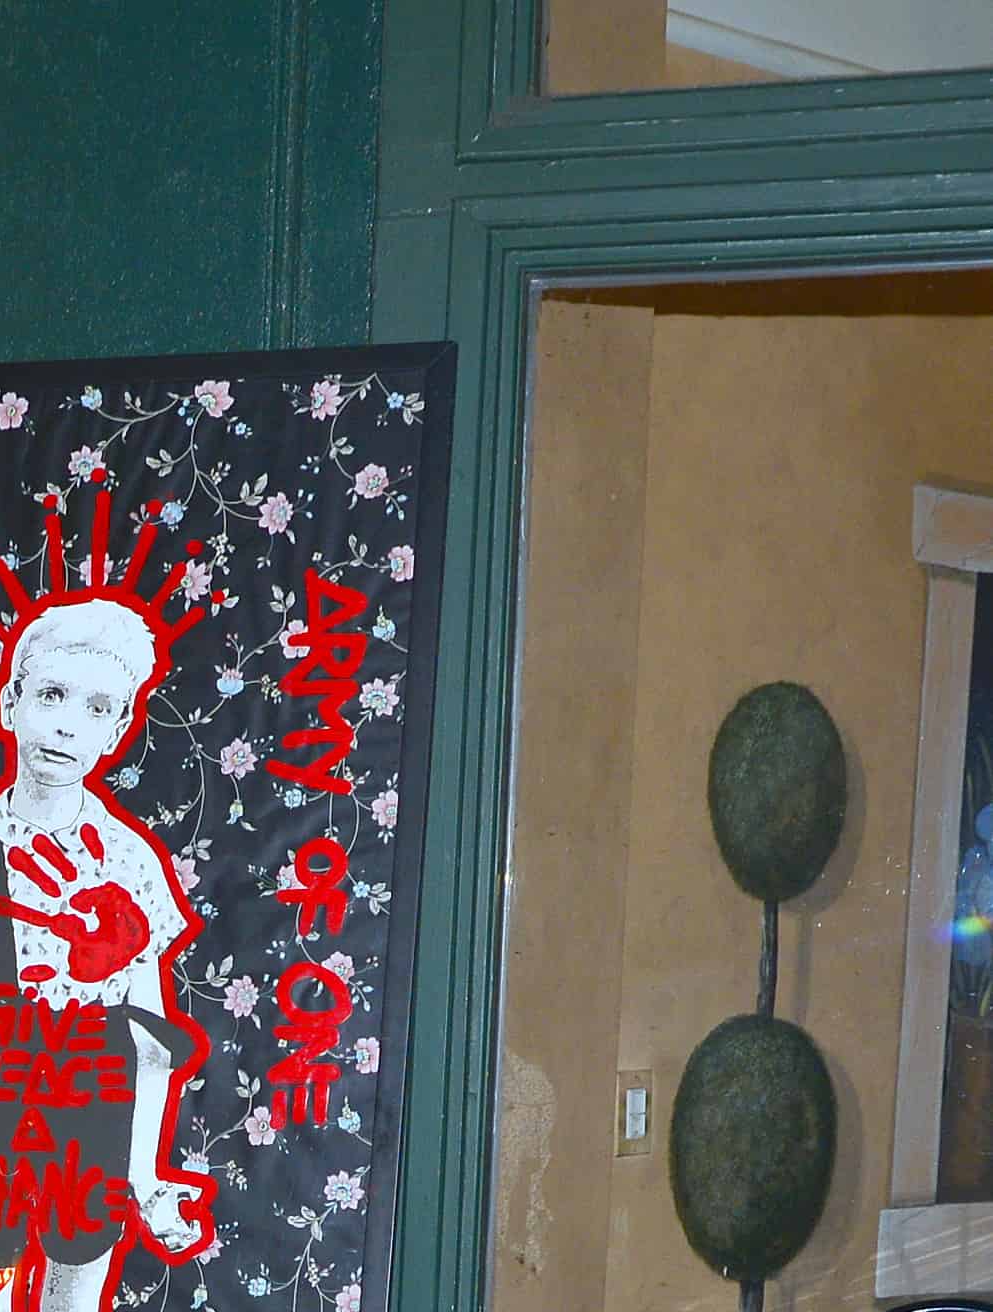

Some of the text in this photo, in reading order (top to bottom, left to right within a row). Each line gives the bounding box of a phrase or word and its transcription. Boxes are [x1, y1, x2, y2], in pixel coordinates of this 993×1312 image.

[266, 568, 368, 1129] ARMY OF ONE
[11, 1107, 57, 1152] A
